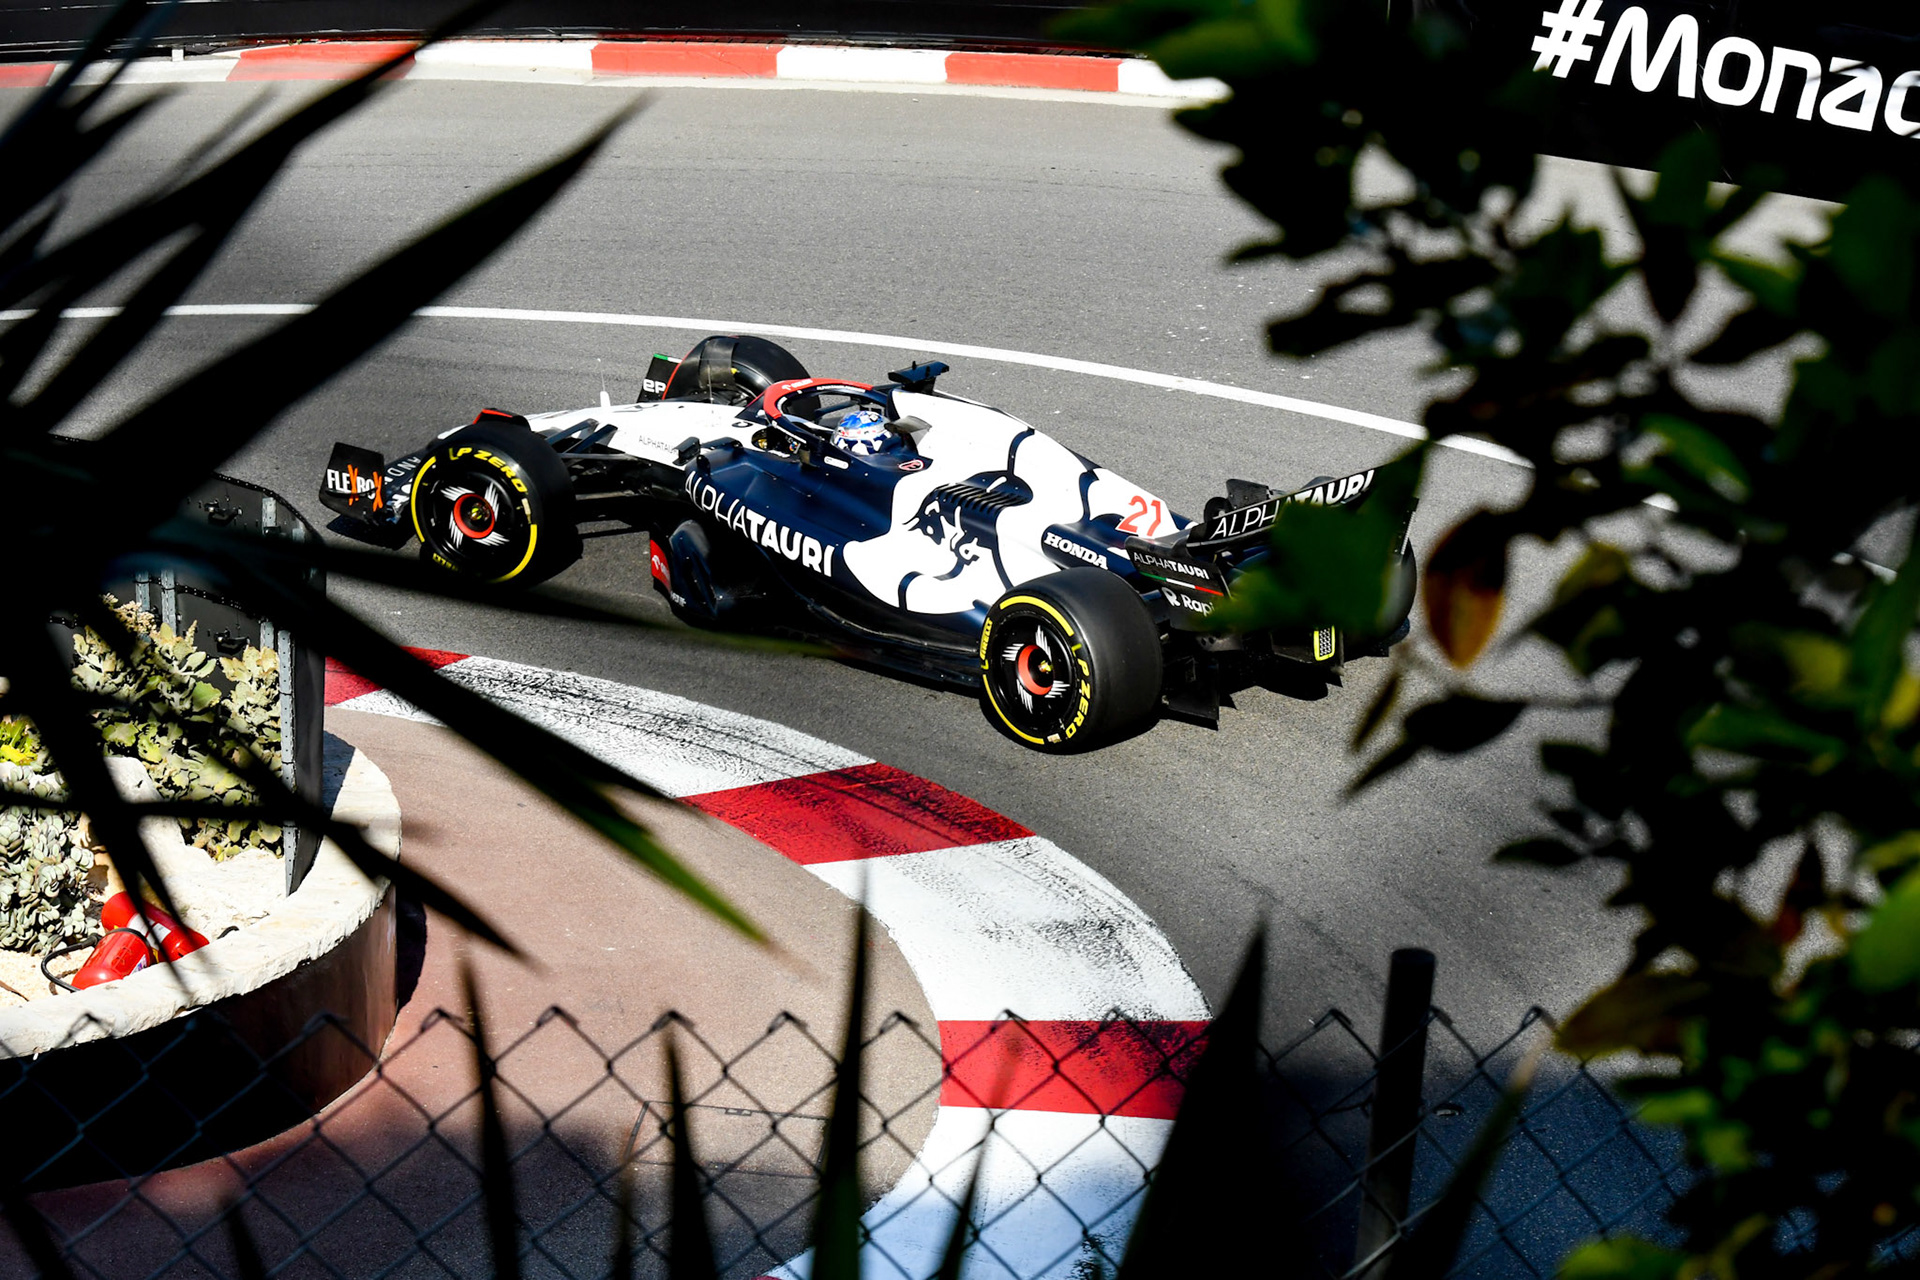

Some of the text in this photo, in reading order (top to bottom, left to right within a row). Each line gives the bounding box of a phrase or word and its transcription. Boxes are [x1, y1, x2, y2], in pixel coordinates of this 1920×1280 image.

[474, 450, 527, 493] ZERO
[685, 471, 835, 577] ALPHATAURI
[1118, 495, 1161, 537] 21
[1044, 532, 1108, 570] HONDA
[1133, 552, 1210, 580] ALPHATAURI
[1065, 679, 1091, 738] ZERO
